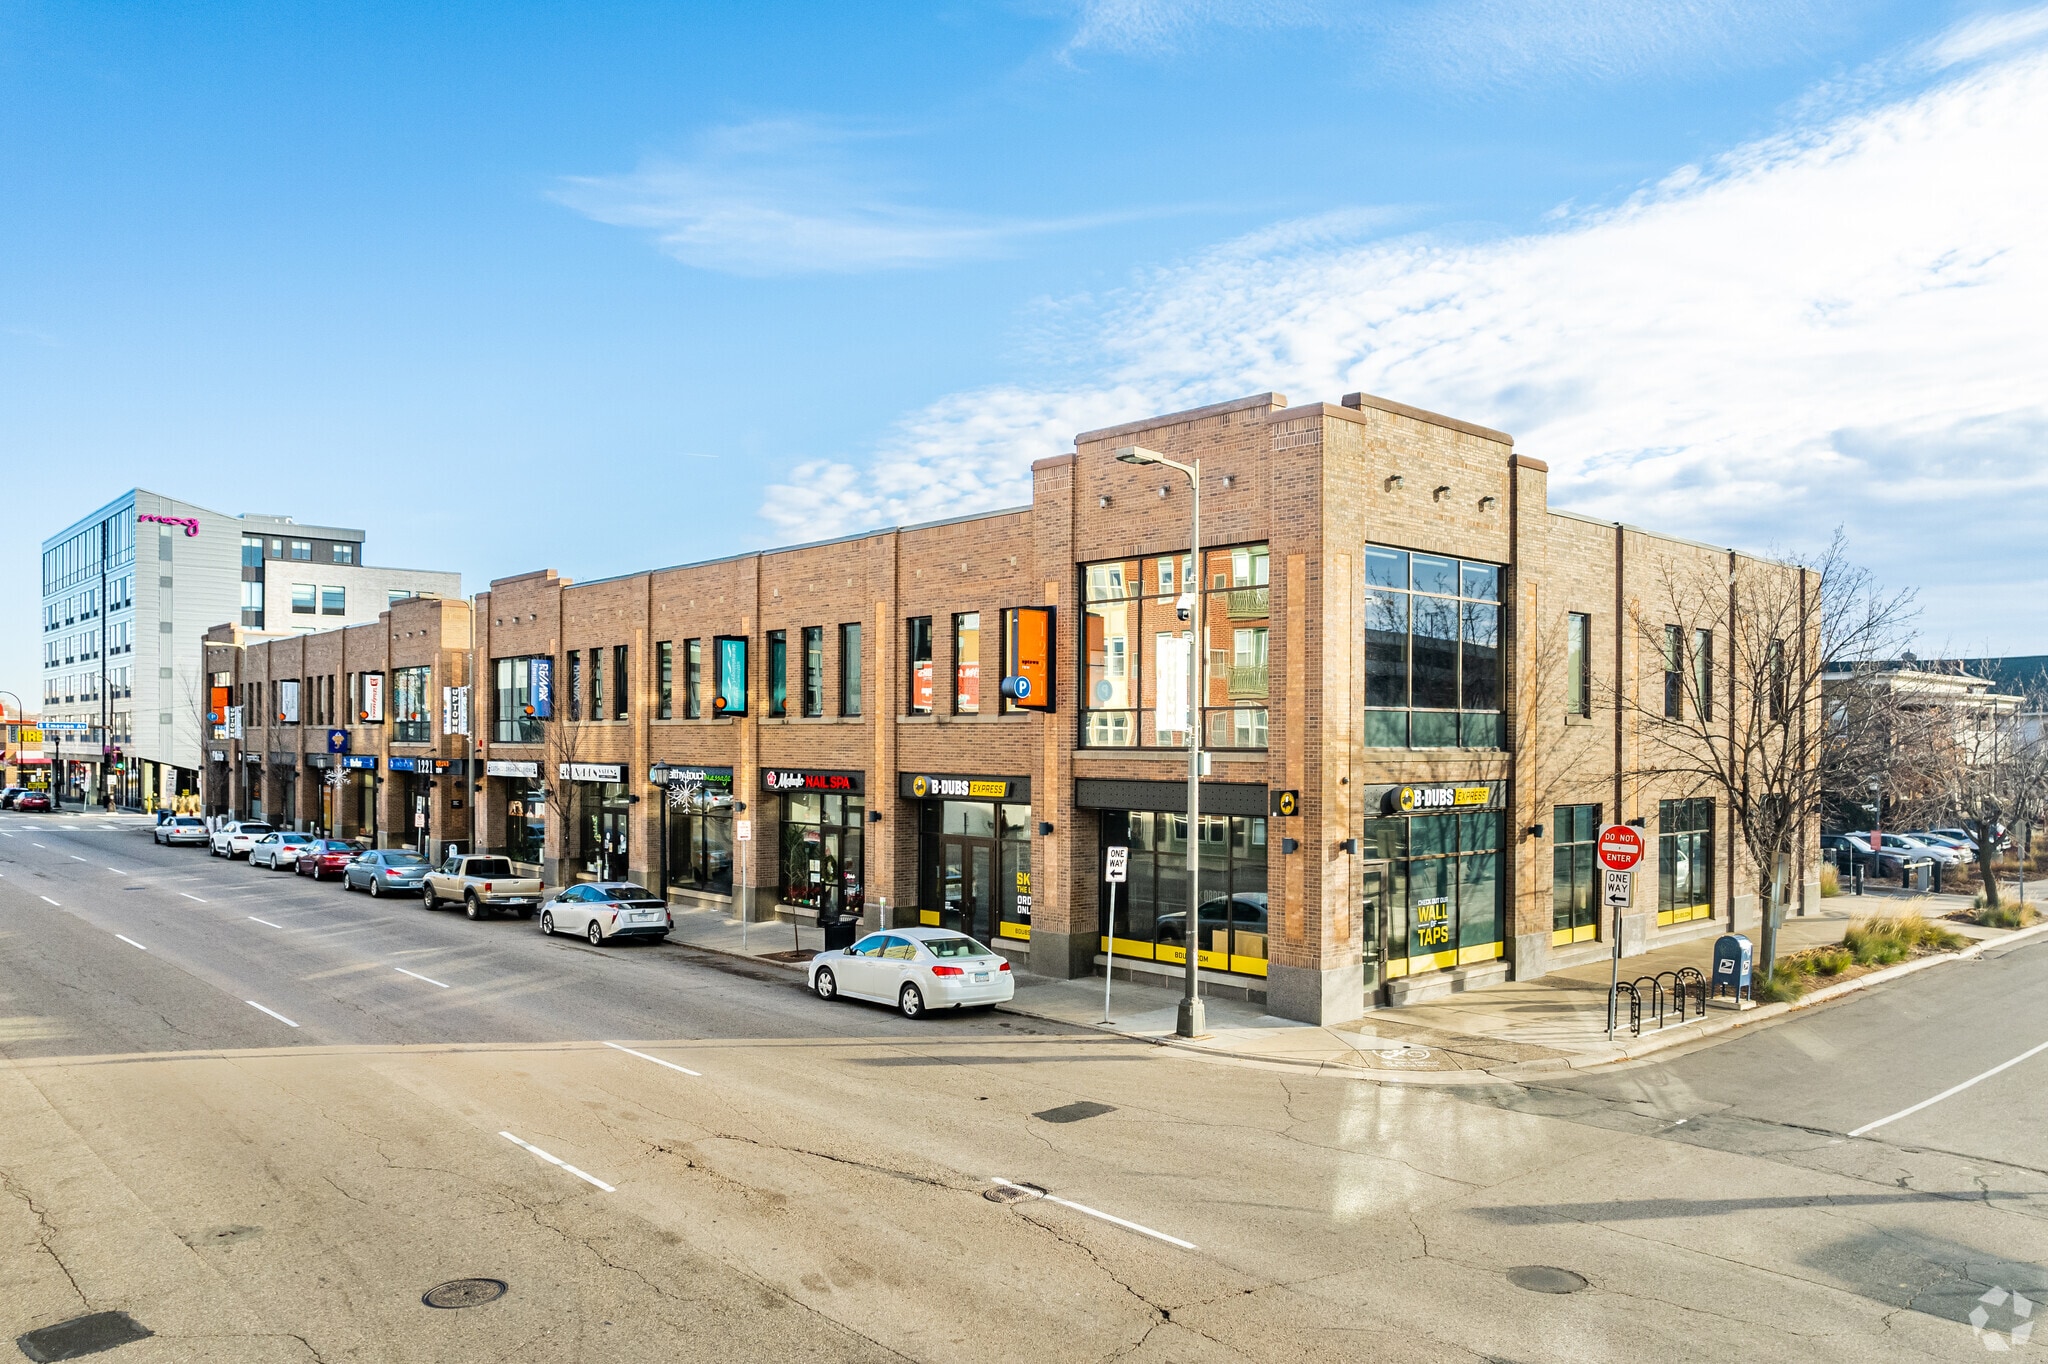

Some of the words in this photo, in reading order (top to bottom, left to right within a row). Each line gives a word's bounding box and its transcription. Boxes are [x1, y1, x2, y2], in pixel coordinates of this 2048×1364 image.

[139, 513, 199, 537] moxy
[1019, 680, 1028, 694] P
[417, 759, 433, 774] 1221
[805, 776, 828, 788] NAIL
[829, 776, 850, 789] SPA
[972, 784, 1003, 793] EXPRESS
[1457, 790, 1487, 801] EXPRESS
[1620, 834, 1634, 842] NOT
[1110, 849, 1125, 858] ONE
[1607, 853, 1631, 862] ENTER
[1109, 859, 1124, 867] WAY
[1016, 872, 1031, 885] SK
[1609, 873, 1628, 883] ONE
[1608, 883, 1628, 893] WAY
[1017, 895, 1031, 905] ORD
[1017, 905, 1031, 915] ONL
[1417, 903, 1449, 922] WALL
[1014, 928, 1031, 936] BDUBS
[1417, 925, 1449, 946] TAPS
[1174, 951, 1209, 963] BDUOM
